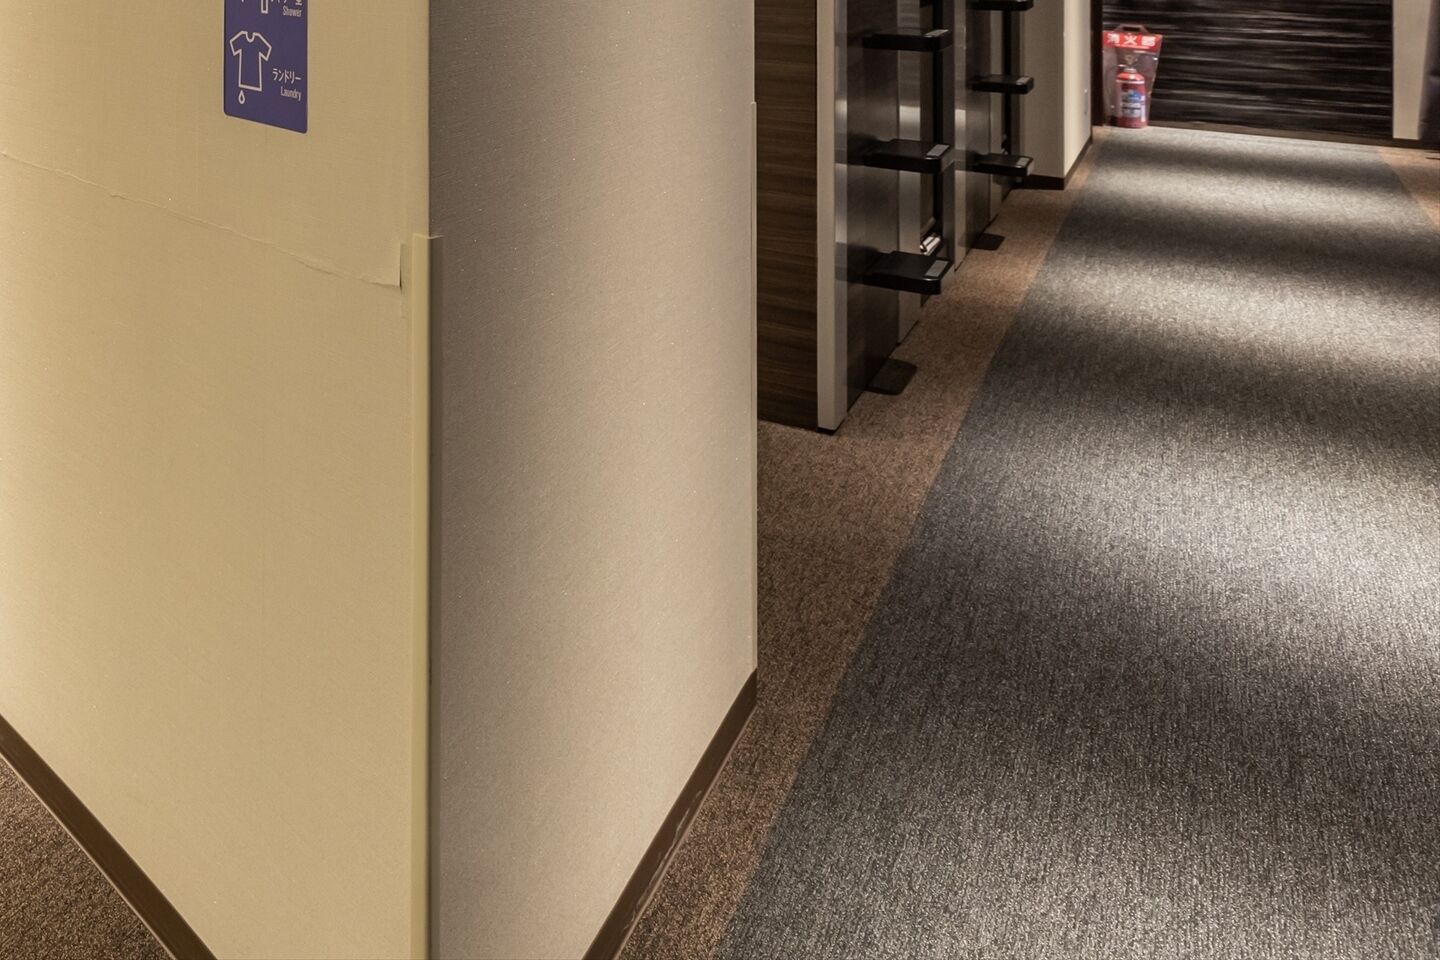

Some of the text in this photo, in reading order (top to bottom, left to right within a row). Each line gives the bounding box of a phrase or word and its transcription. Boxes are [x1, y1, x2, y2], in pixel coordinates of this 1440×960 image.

[282, 5, 302, 17] Shower
[272, 67, 302, 84] ランドリー
[280, 85, 302, 102] Laundry
